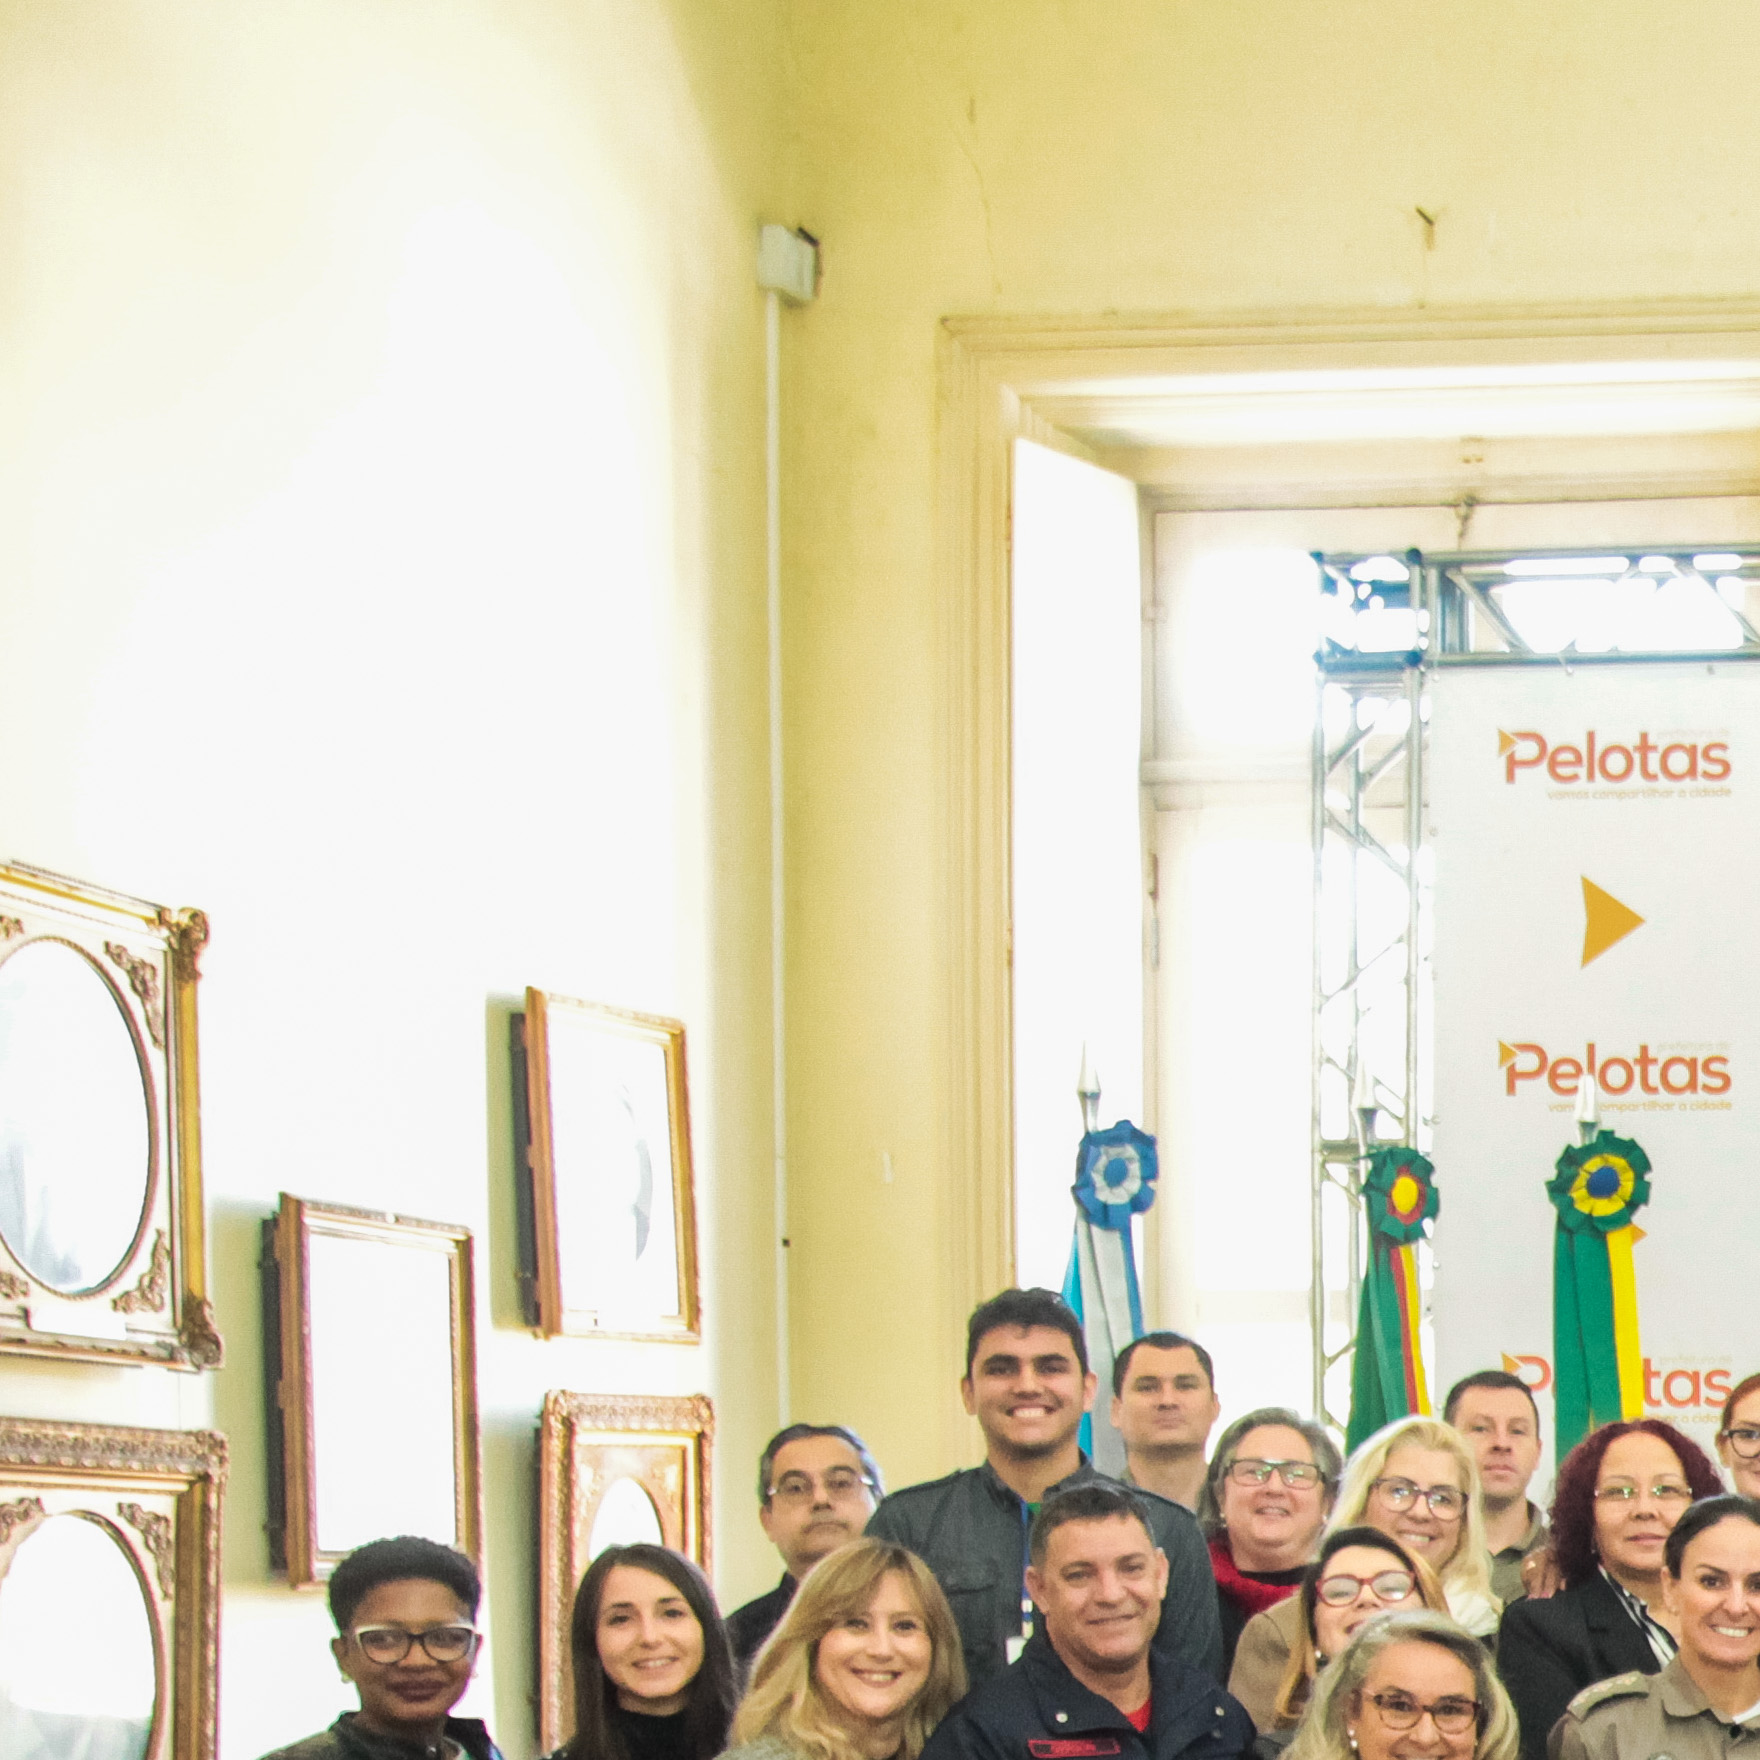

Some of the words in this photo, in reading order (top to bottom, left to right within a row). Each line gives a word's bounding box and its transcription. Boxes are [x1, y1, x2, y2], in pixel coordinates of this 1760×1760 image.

[1505, 728, 1732, 784] Pelotas
[1506, 1041, 1732, 1096] Pelotas
[1547, 1103, 1575, 1112] vam
[1599, 1100, 1675, 1114] ompartilhar
[1689, 1100, 1732, 1111] cidade
